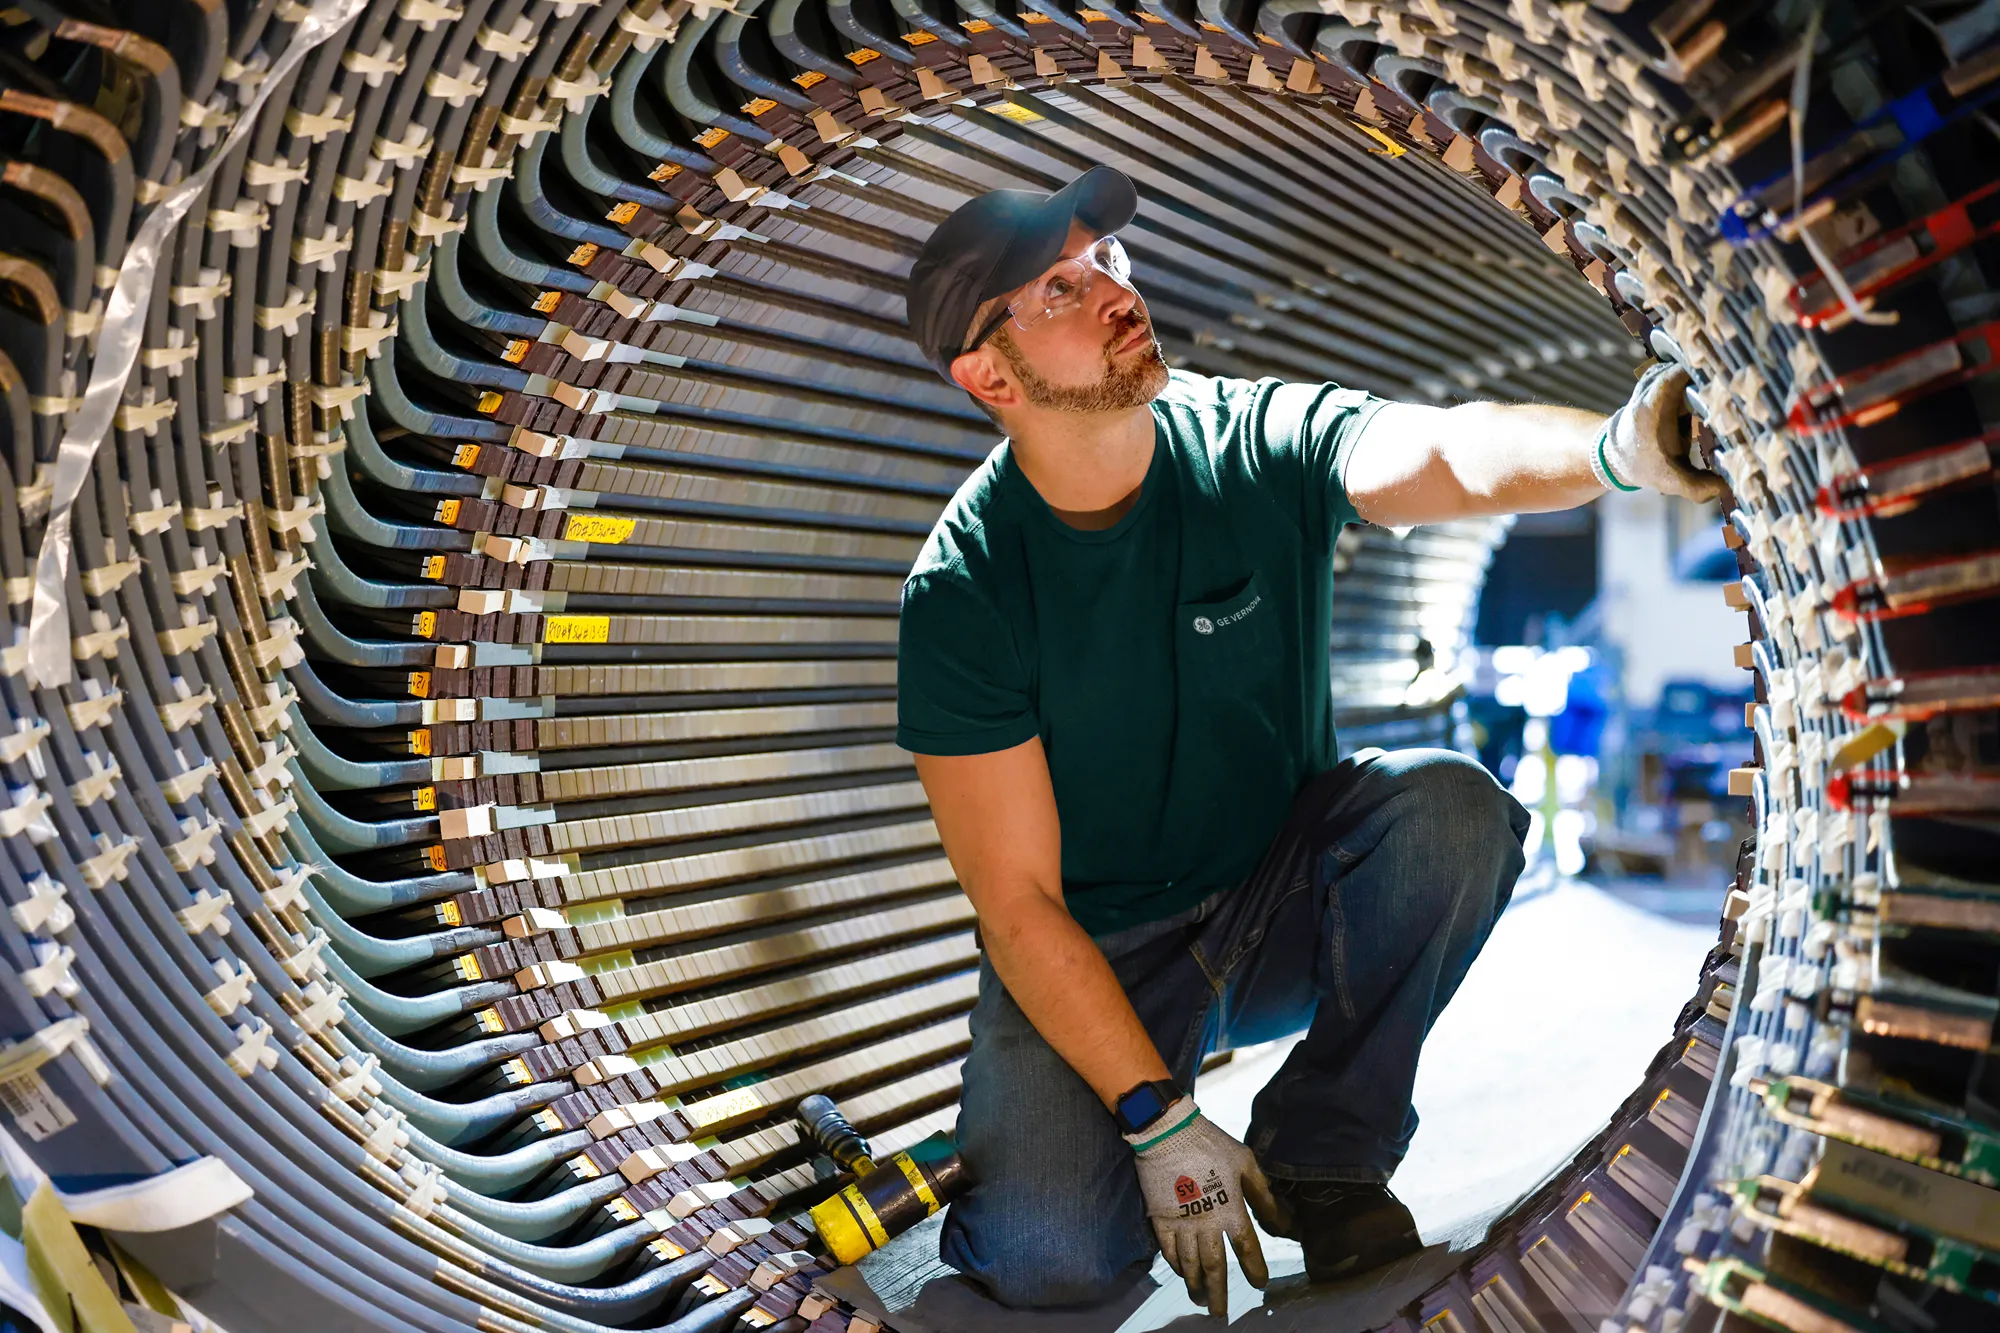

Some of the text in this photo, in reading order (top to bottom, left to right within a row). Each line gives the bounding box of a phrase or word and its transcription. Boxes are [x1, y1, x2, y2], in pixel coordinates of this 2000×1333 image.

[1216, 617, 1231, 627] GE
[1230, 595, 1261, 622] VERNOVA
[1209, 1169, 1216, 1177] 8
[1177, 1181, 1195, 1197] A5
